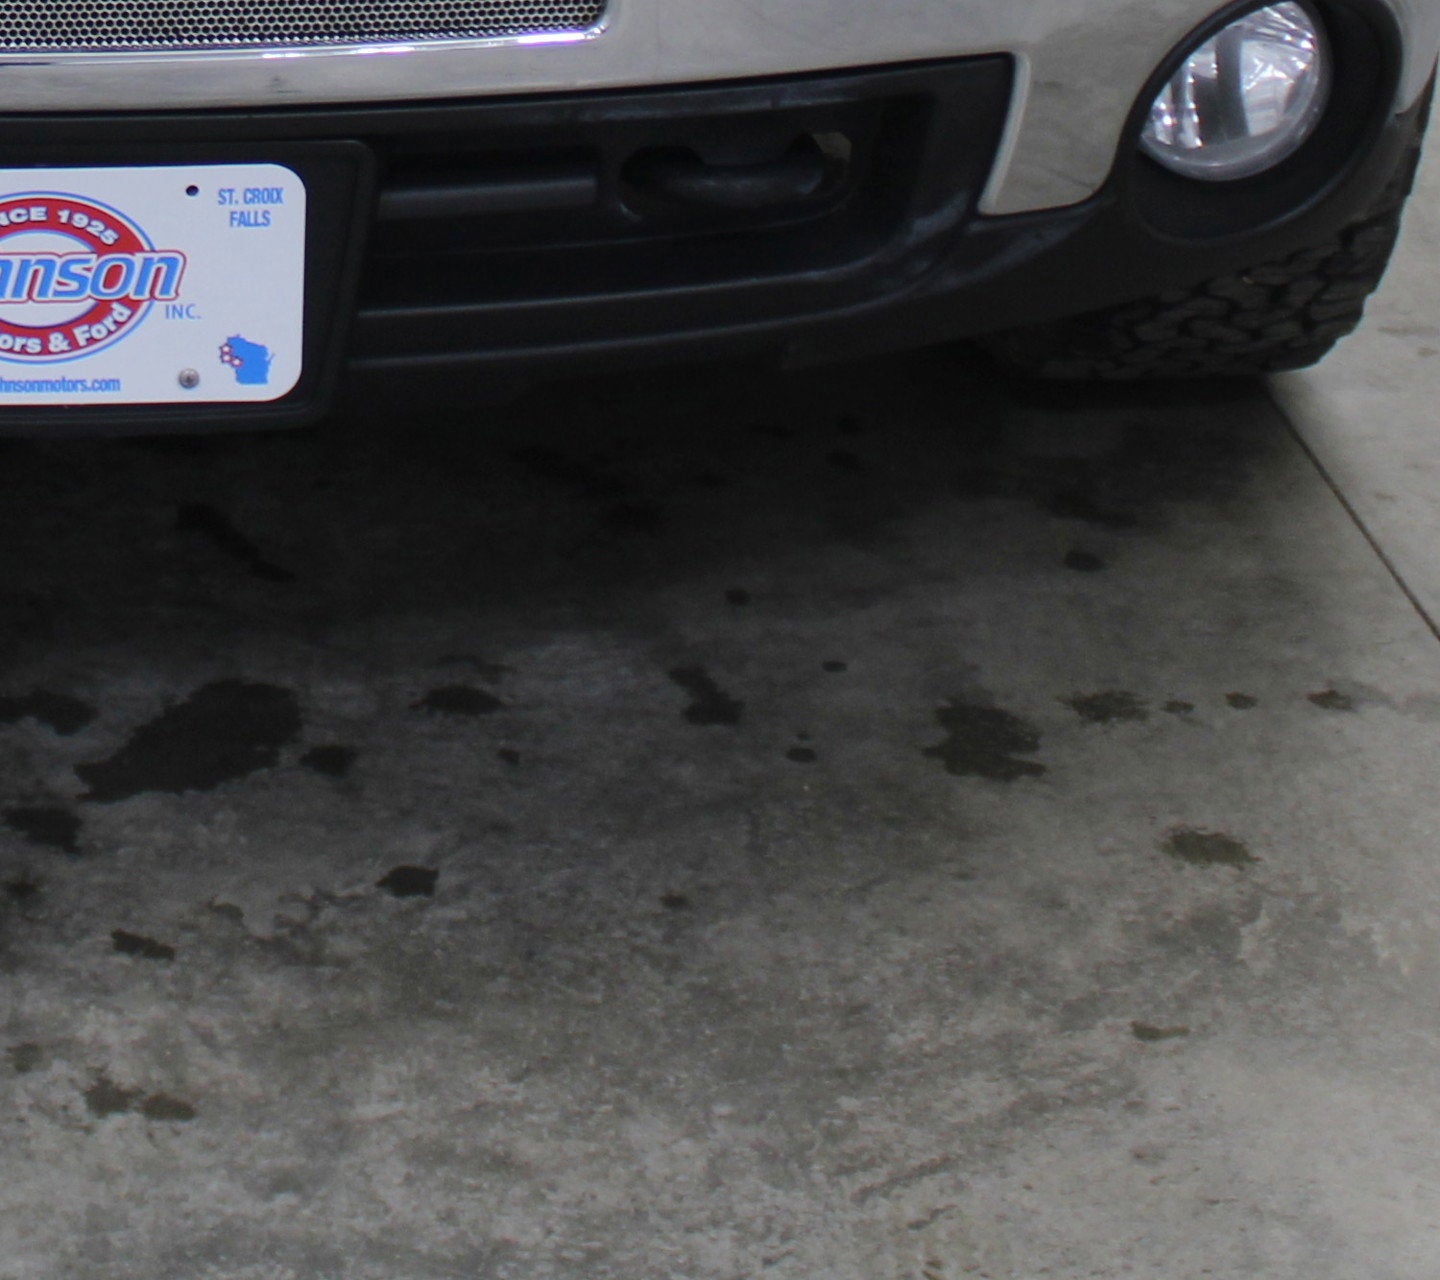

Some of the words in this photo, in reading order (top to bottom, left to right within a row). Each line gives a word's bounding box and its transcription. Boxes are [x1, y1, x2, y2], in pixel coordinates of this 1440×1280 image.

[218, 188, 239, 205] ST.
[243, 187, 284, 204] CROIX
[56, 209, 119, 245] 1925
[229, 210, 271, 227] FALLS
[164, 304, 202, 320] INC.
[47, 332, 72, 353] &
[72, 302, 134, 347] Ford
